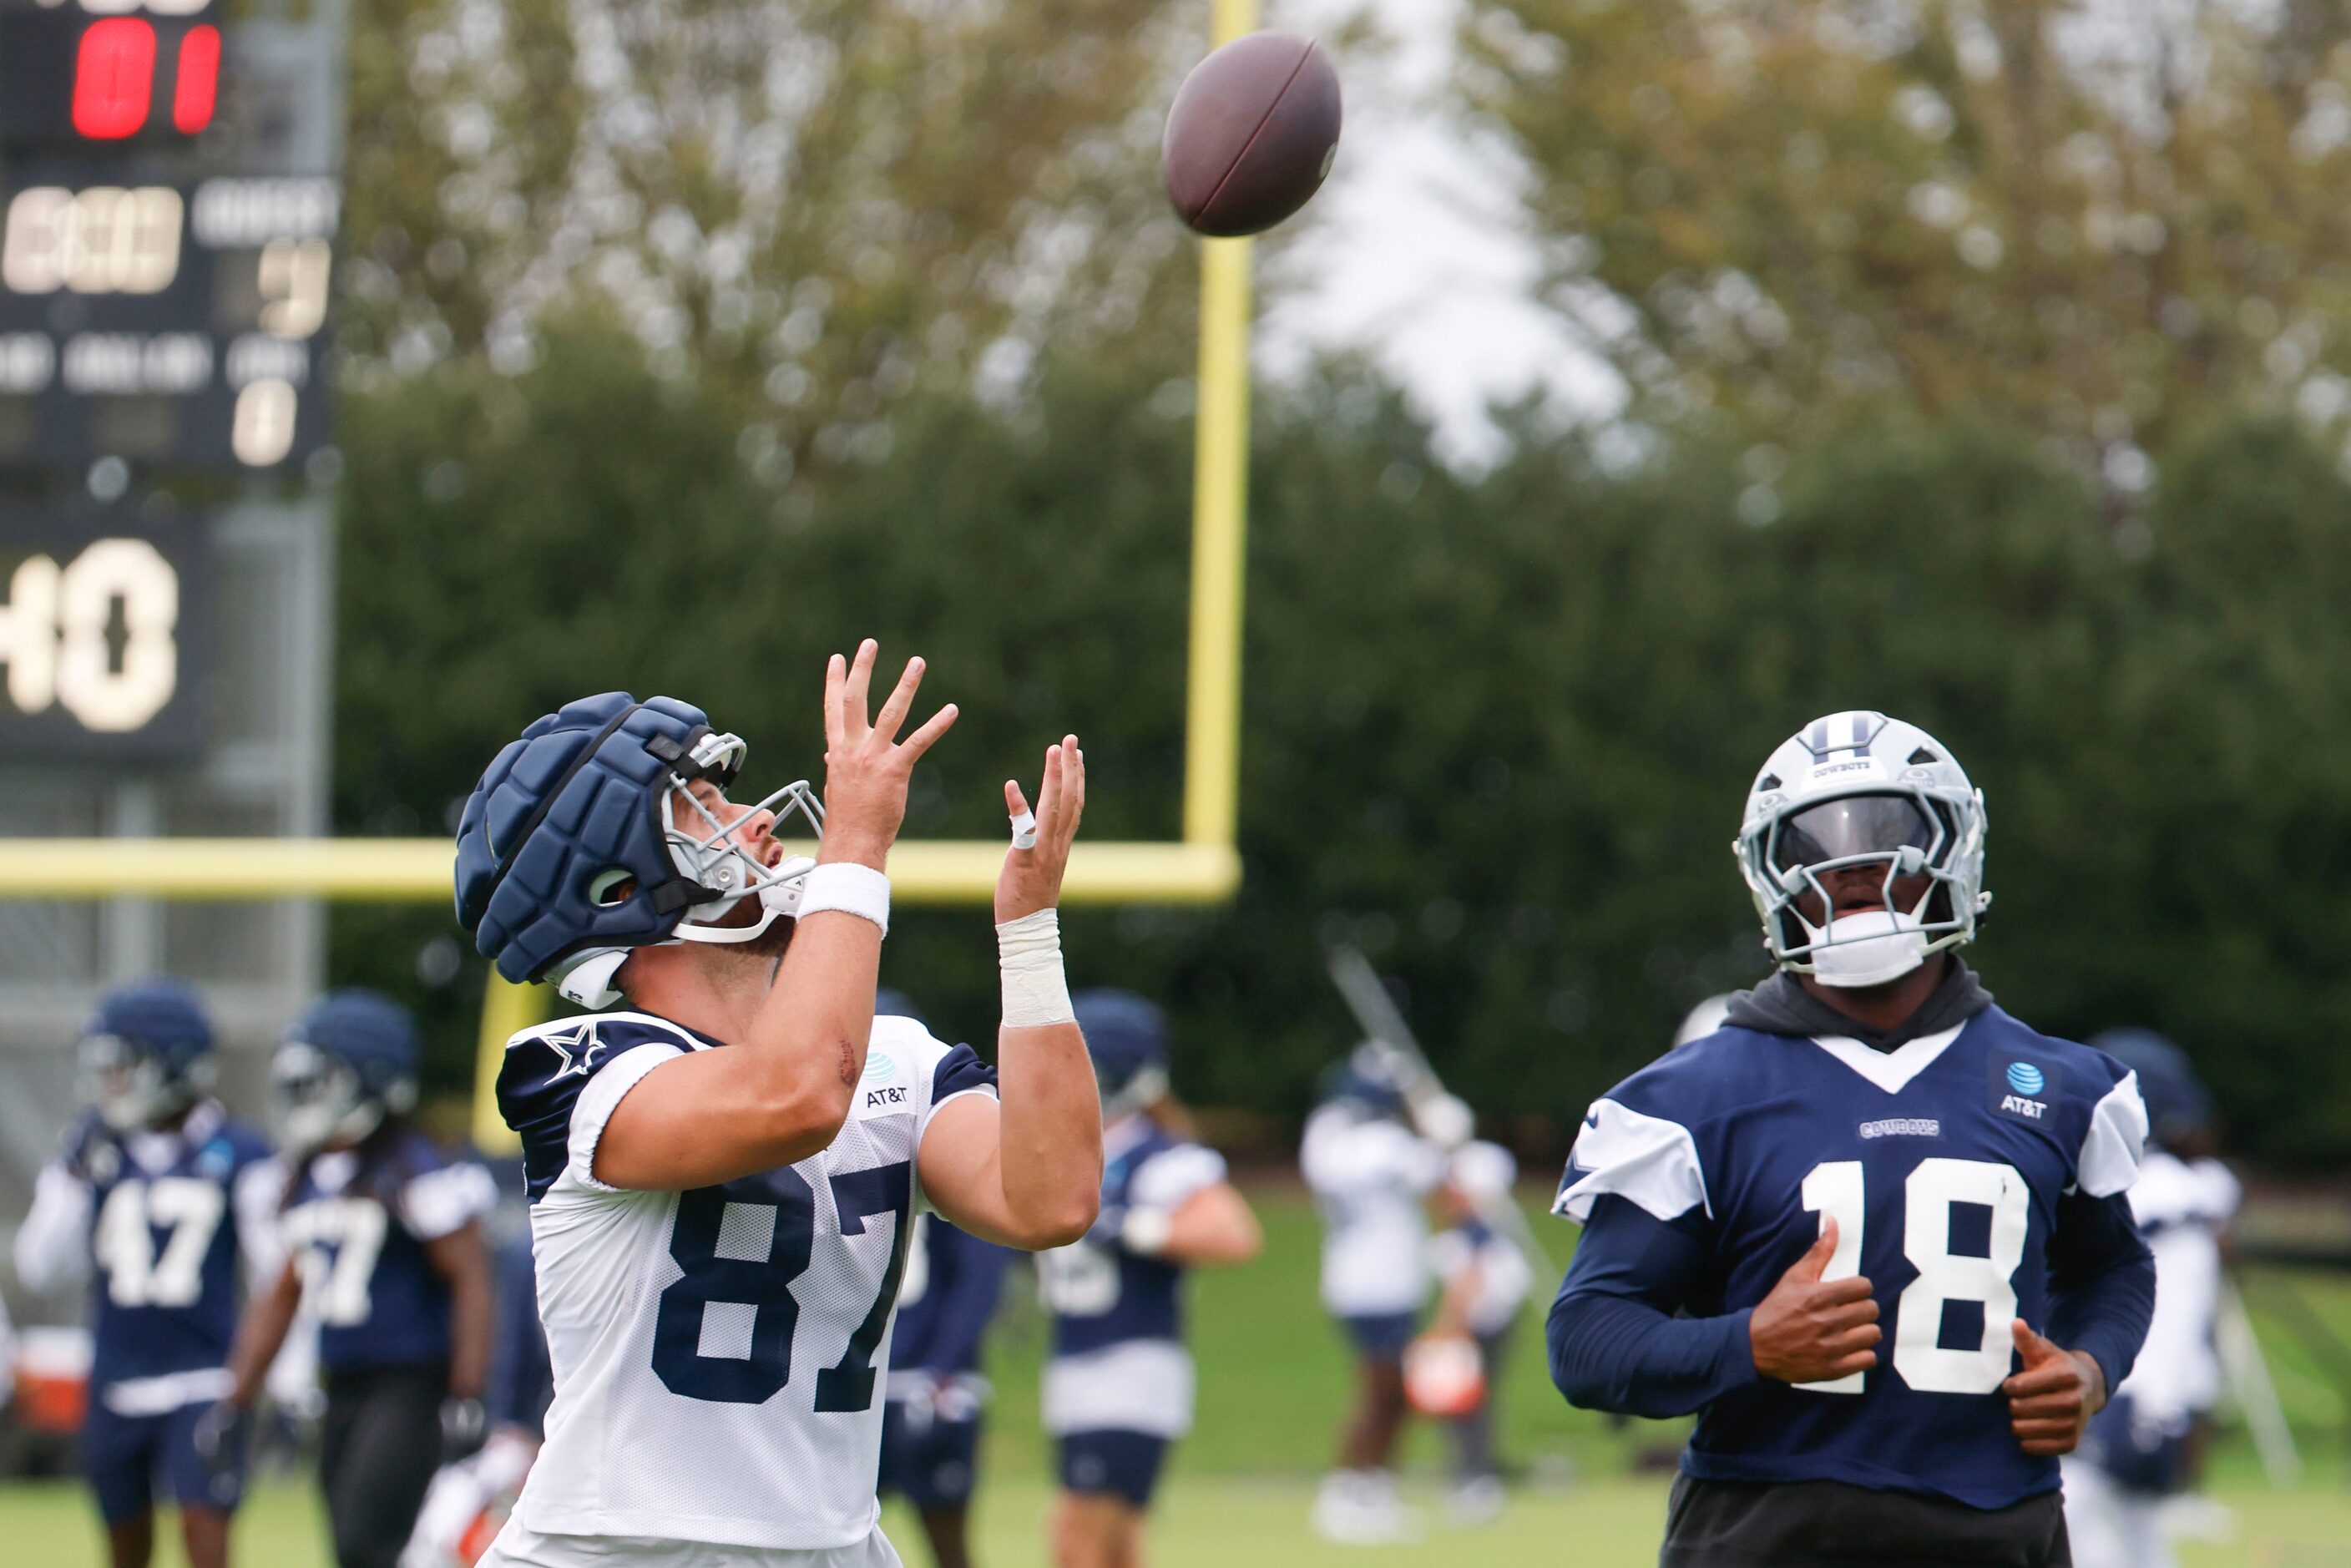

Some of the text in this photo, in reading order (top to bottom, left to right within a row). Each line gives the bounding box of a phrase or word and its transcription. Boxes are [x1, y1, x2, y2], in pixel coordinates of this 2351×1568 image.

[1813, 761, 1871, 778] COWBOYS
[867, 1087, 907, 1108] AT&T
[2000, 1095, 2047, 1119] AT&T
[1859, 1119, 1939, 1139] COWBOYS
[95, 1177, 225, 1308] 47
[651, 1161, 911, 1413] 87
[1791, 1157, 2030, 1394] 18
